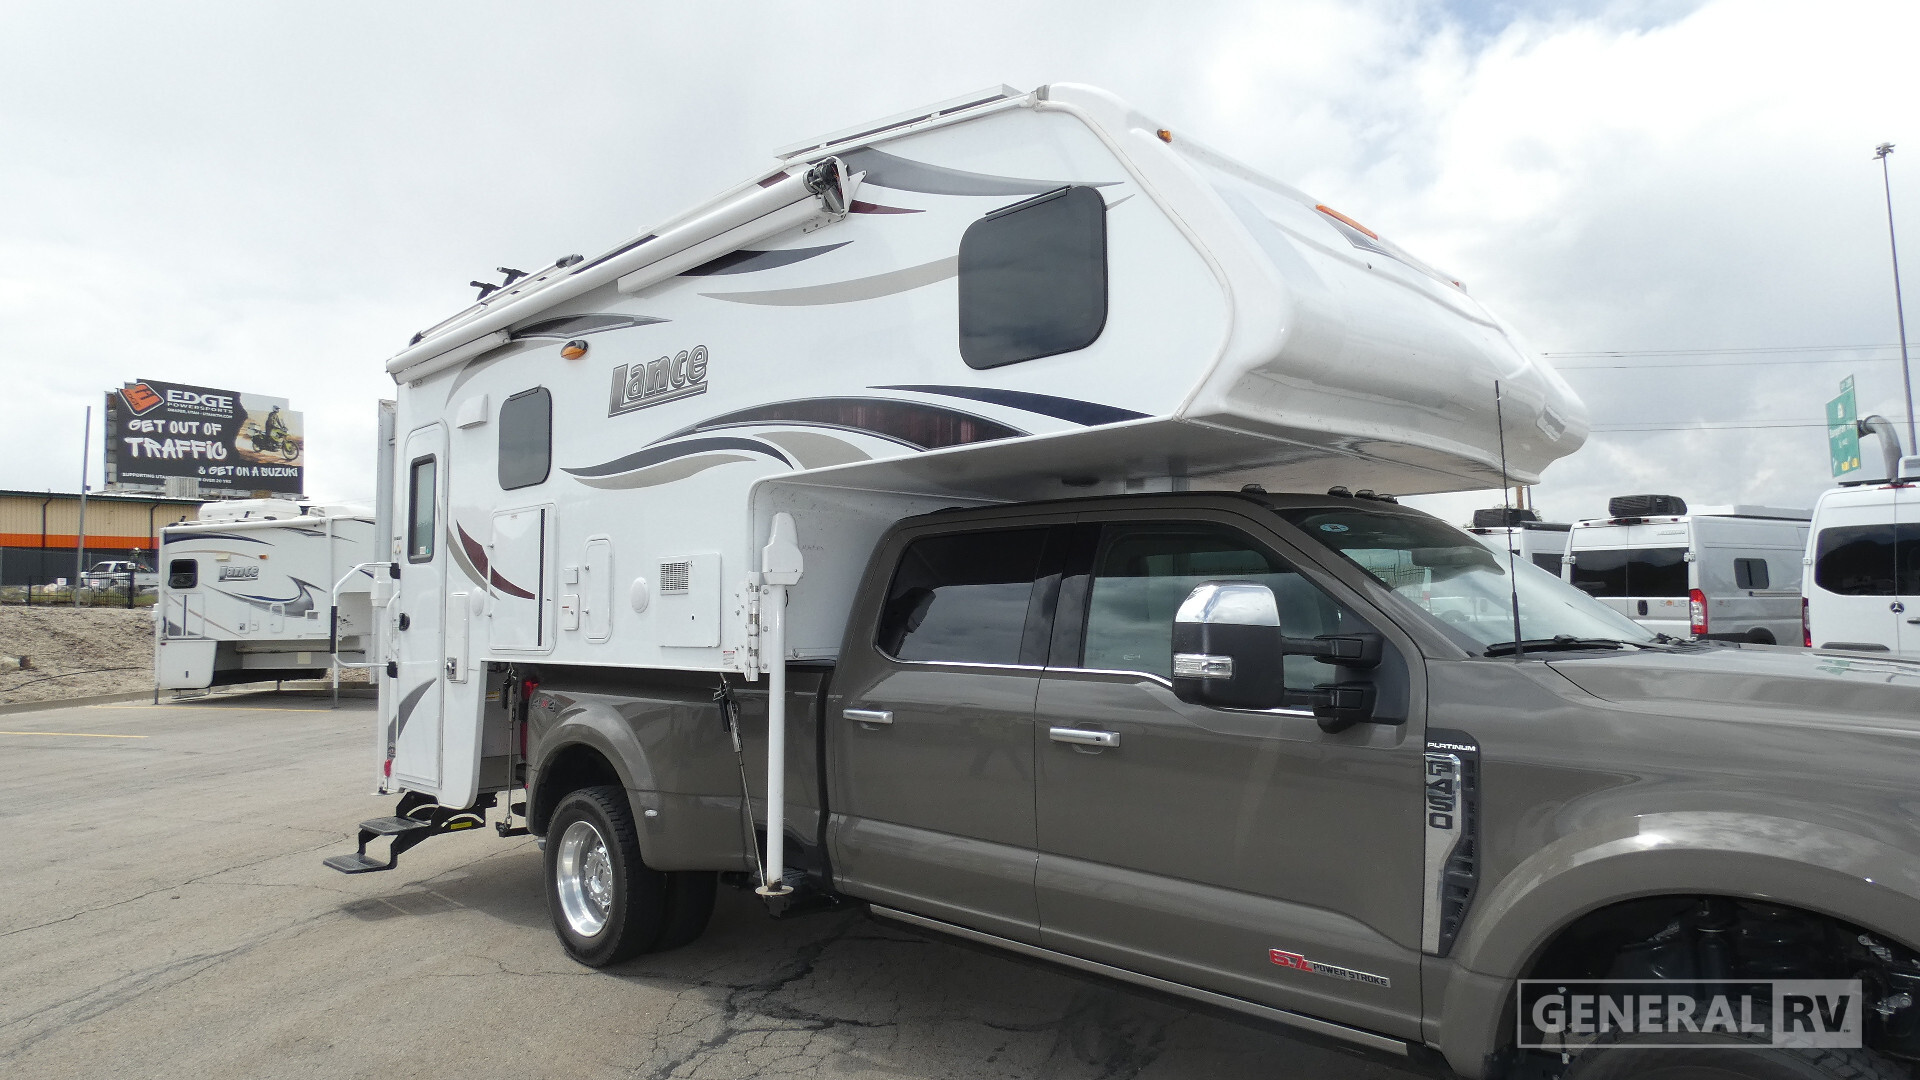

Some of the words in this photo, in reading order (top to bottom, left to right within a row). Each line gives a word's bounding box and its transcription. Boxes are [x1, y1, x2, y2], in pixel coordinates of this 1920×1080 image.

[608, 344, 709, 418] Lance
[167, 390, 233, 409] EDGE
[167, 402, 233, 414] POWERSPORTS
[128, 420, 166, 433] GET
[169, 421, 200, 435] OUT
[203, 422, 222, 436] OF
[198, 466, 206, 475] &
[208, 466, 234, 476] GET
[236, 467, 250, 477] ON
[252, 467, 259, 477] A
[1427, 742, 1476, 752] PLATINUM
[1313, 963, 1346, 977] POWER
[1348, 970, 1388, 987] STROKE
